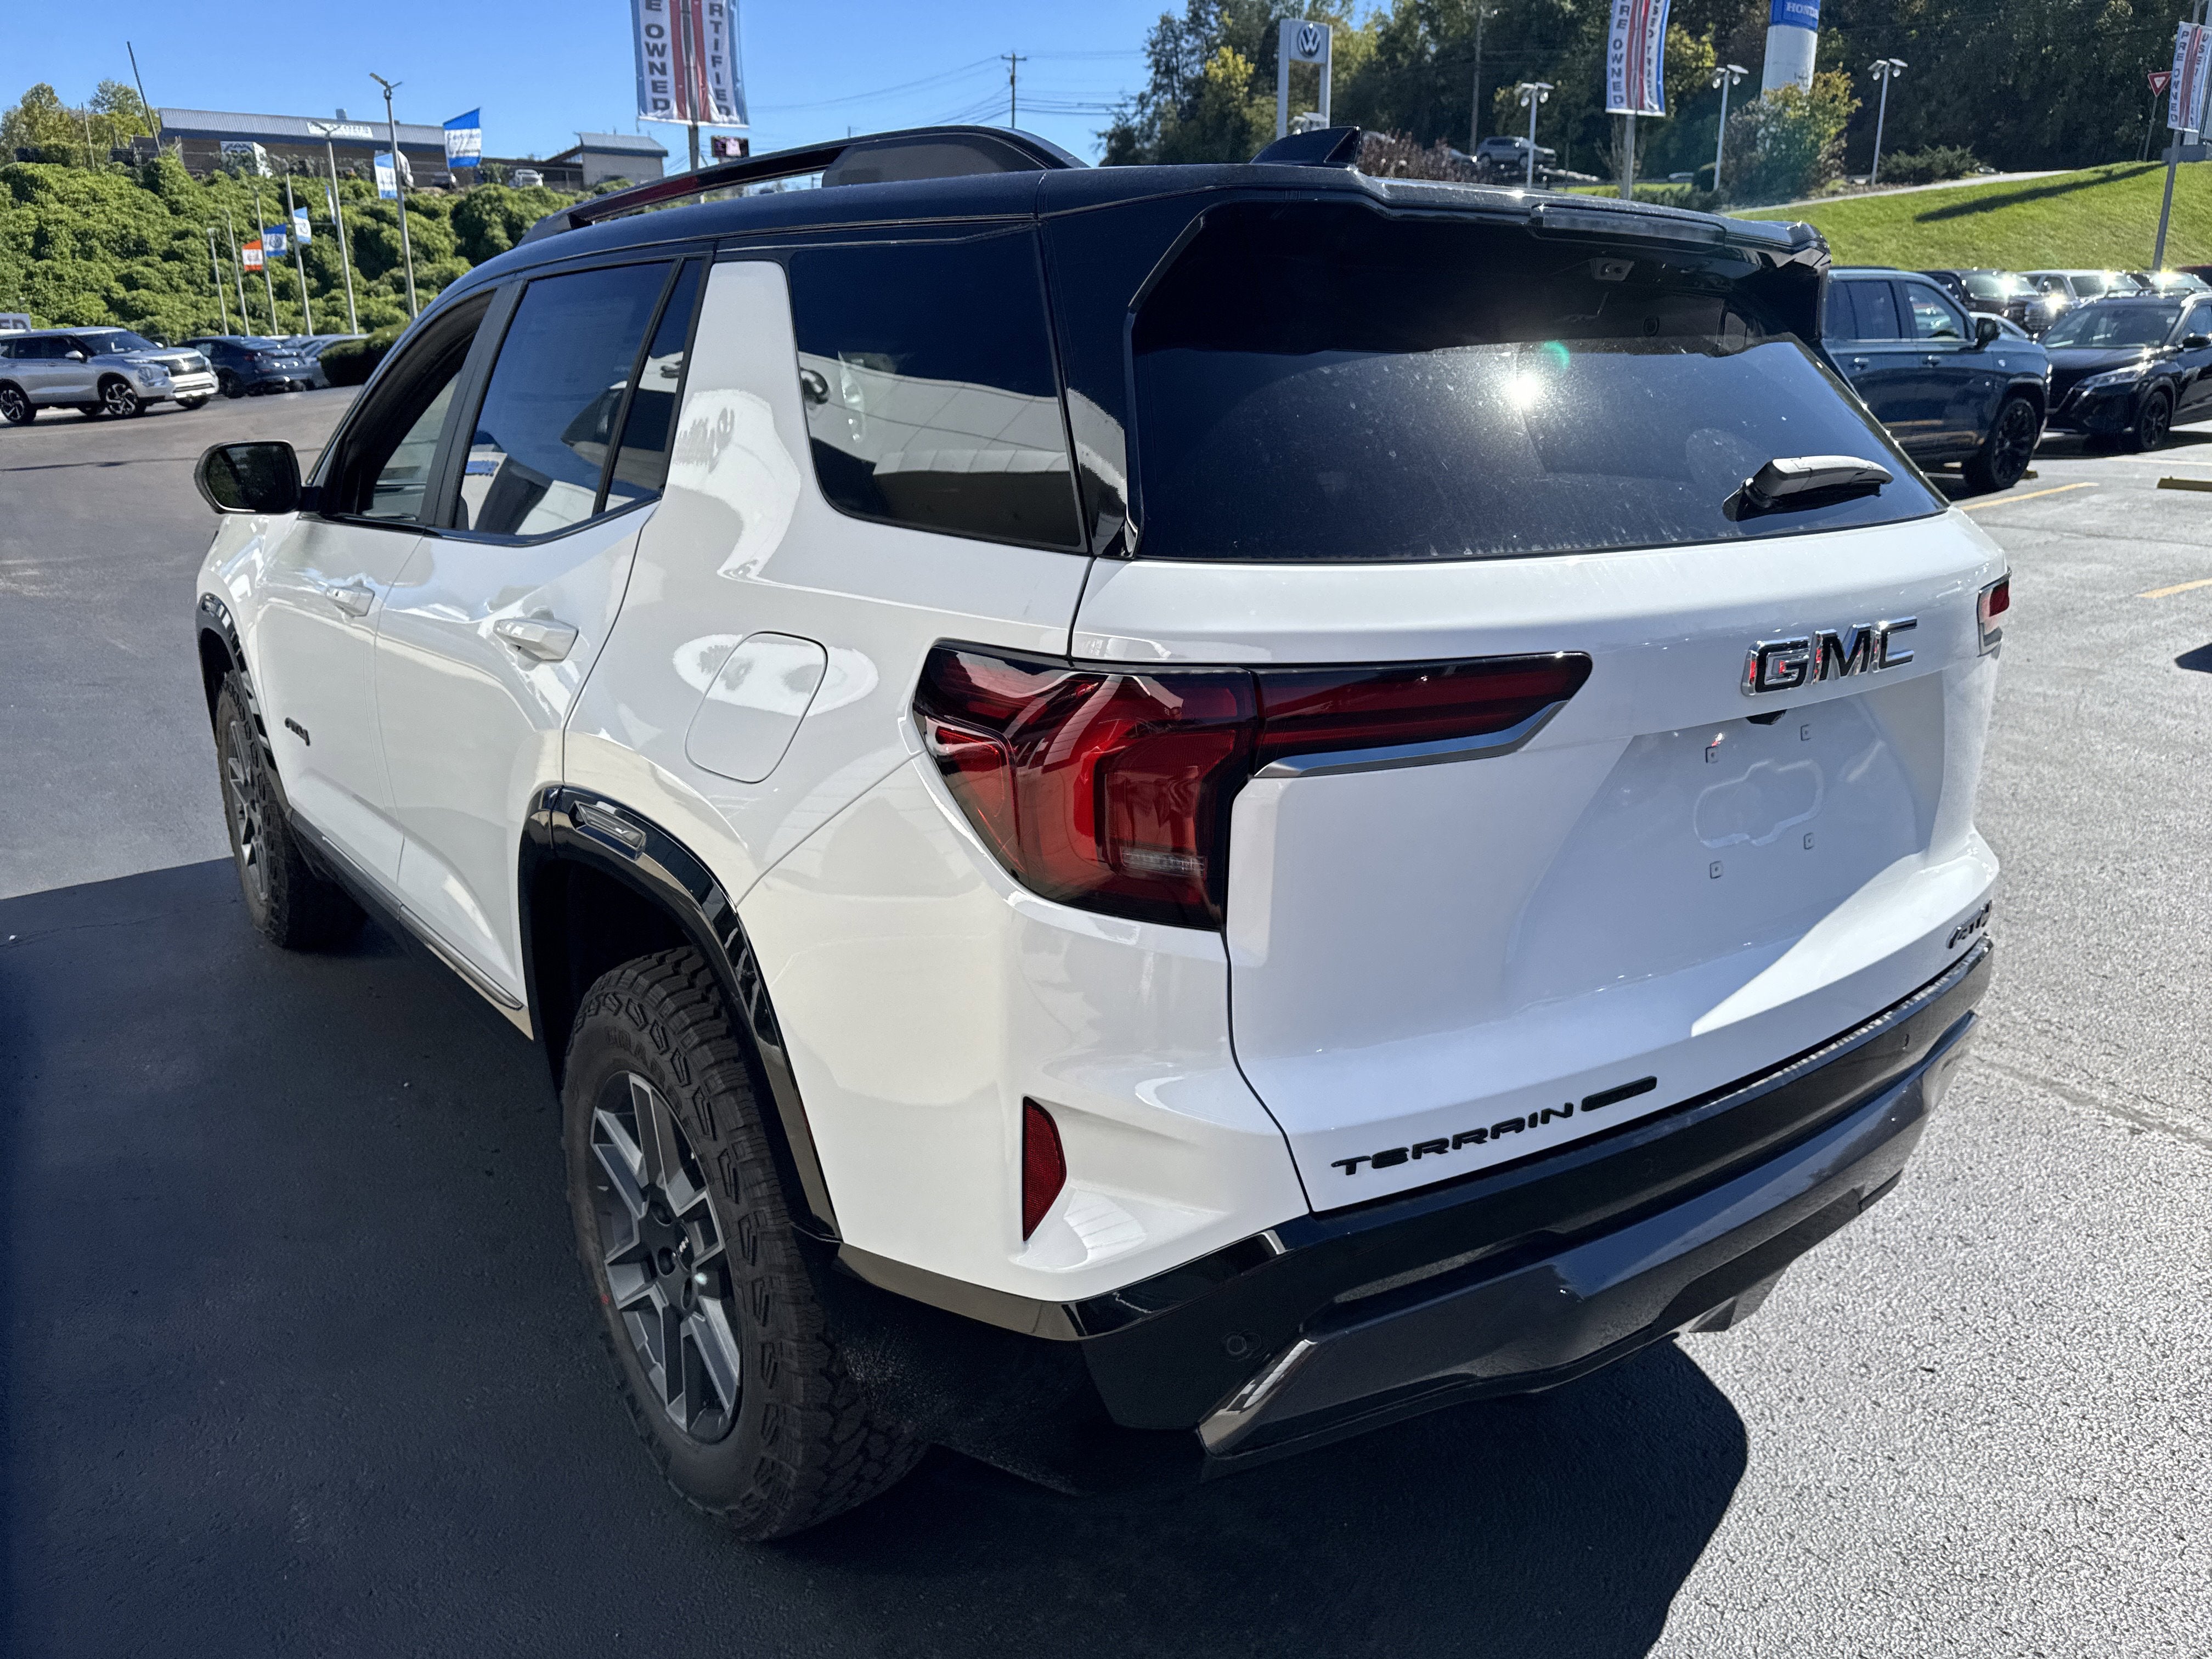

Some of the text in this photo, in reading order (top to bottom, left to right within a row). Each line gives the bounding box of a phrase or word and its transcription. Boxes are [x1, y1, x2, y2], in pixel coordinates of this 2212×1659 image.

[645, 23, 670, 110] OWNED
[1611, 0, 1630, 104] RE OWNED
[2176, 30, 2190, 61] PRE
[1741, 615, 1917, 697] GMC
[1331, 1102, 1574, 1175] TERRAIN
